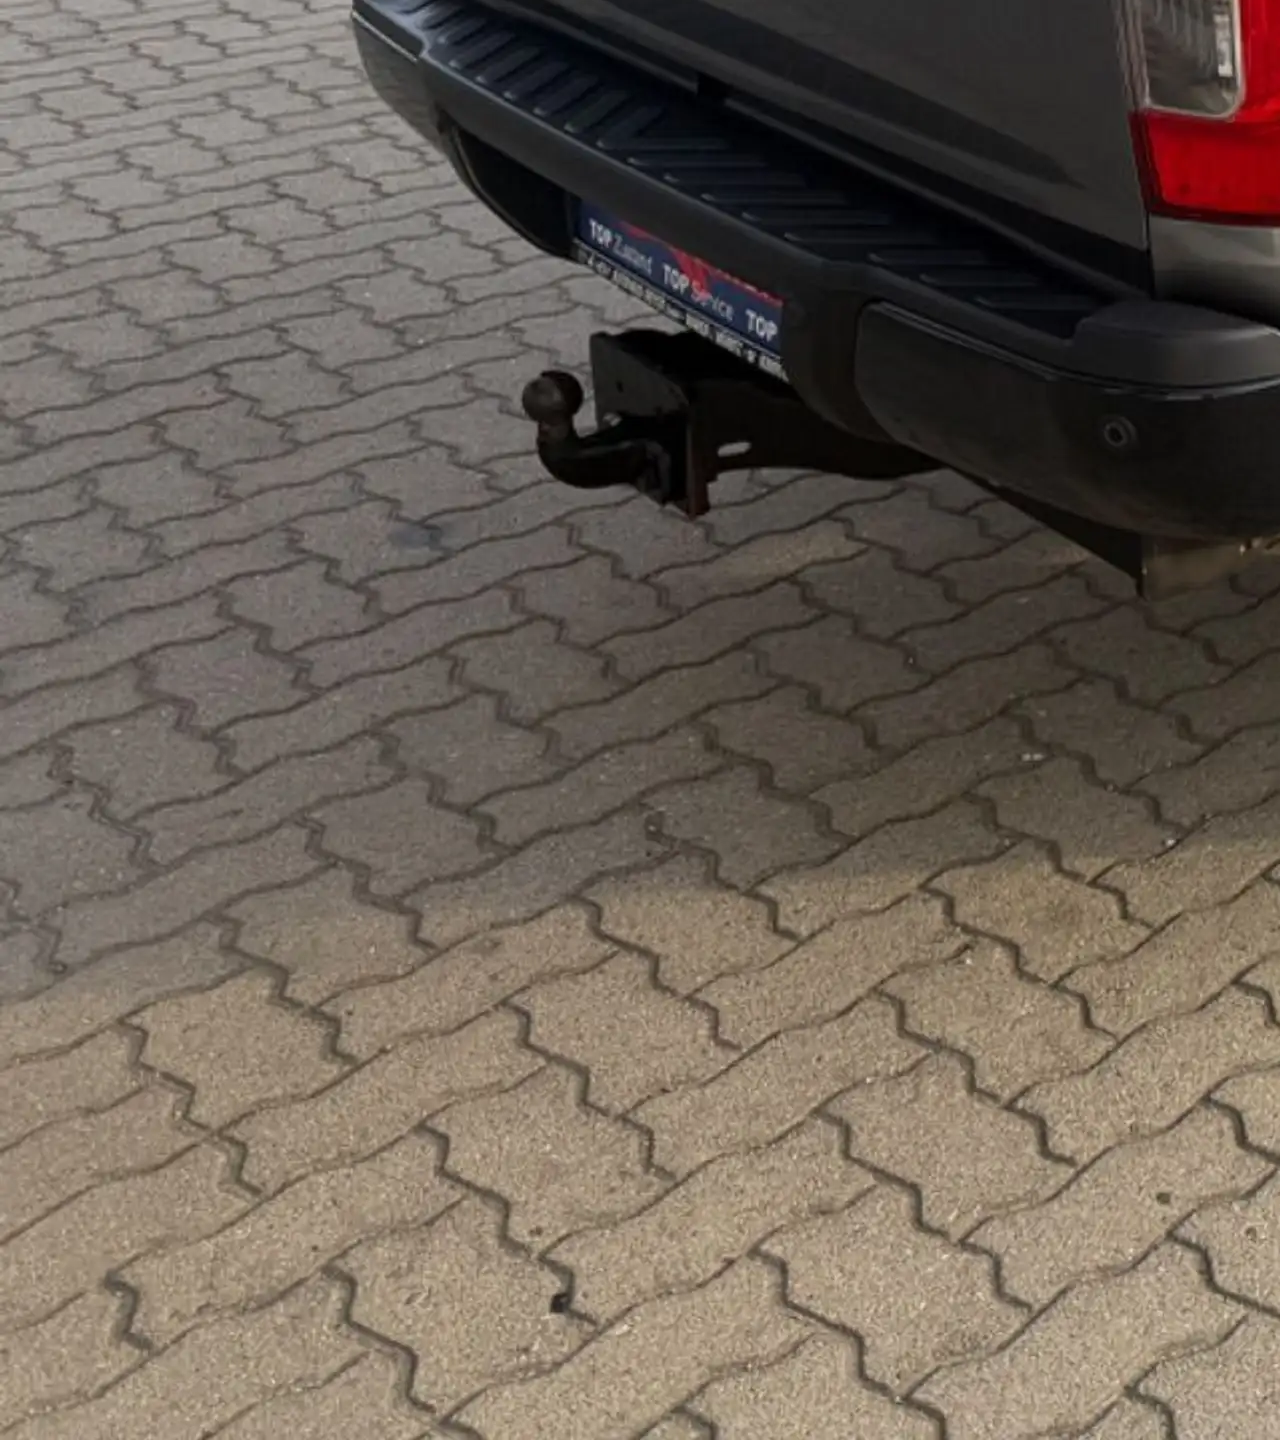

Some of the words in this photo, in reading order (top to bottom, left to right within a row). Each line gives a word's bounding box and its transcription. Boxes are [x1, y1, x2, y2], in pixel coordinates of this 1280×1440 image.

[588, 217, 613, 249] TOP
[662, 262, 691, 295] TOP
[744, 309, 779, 343] TOP
